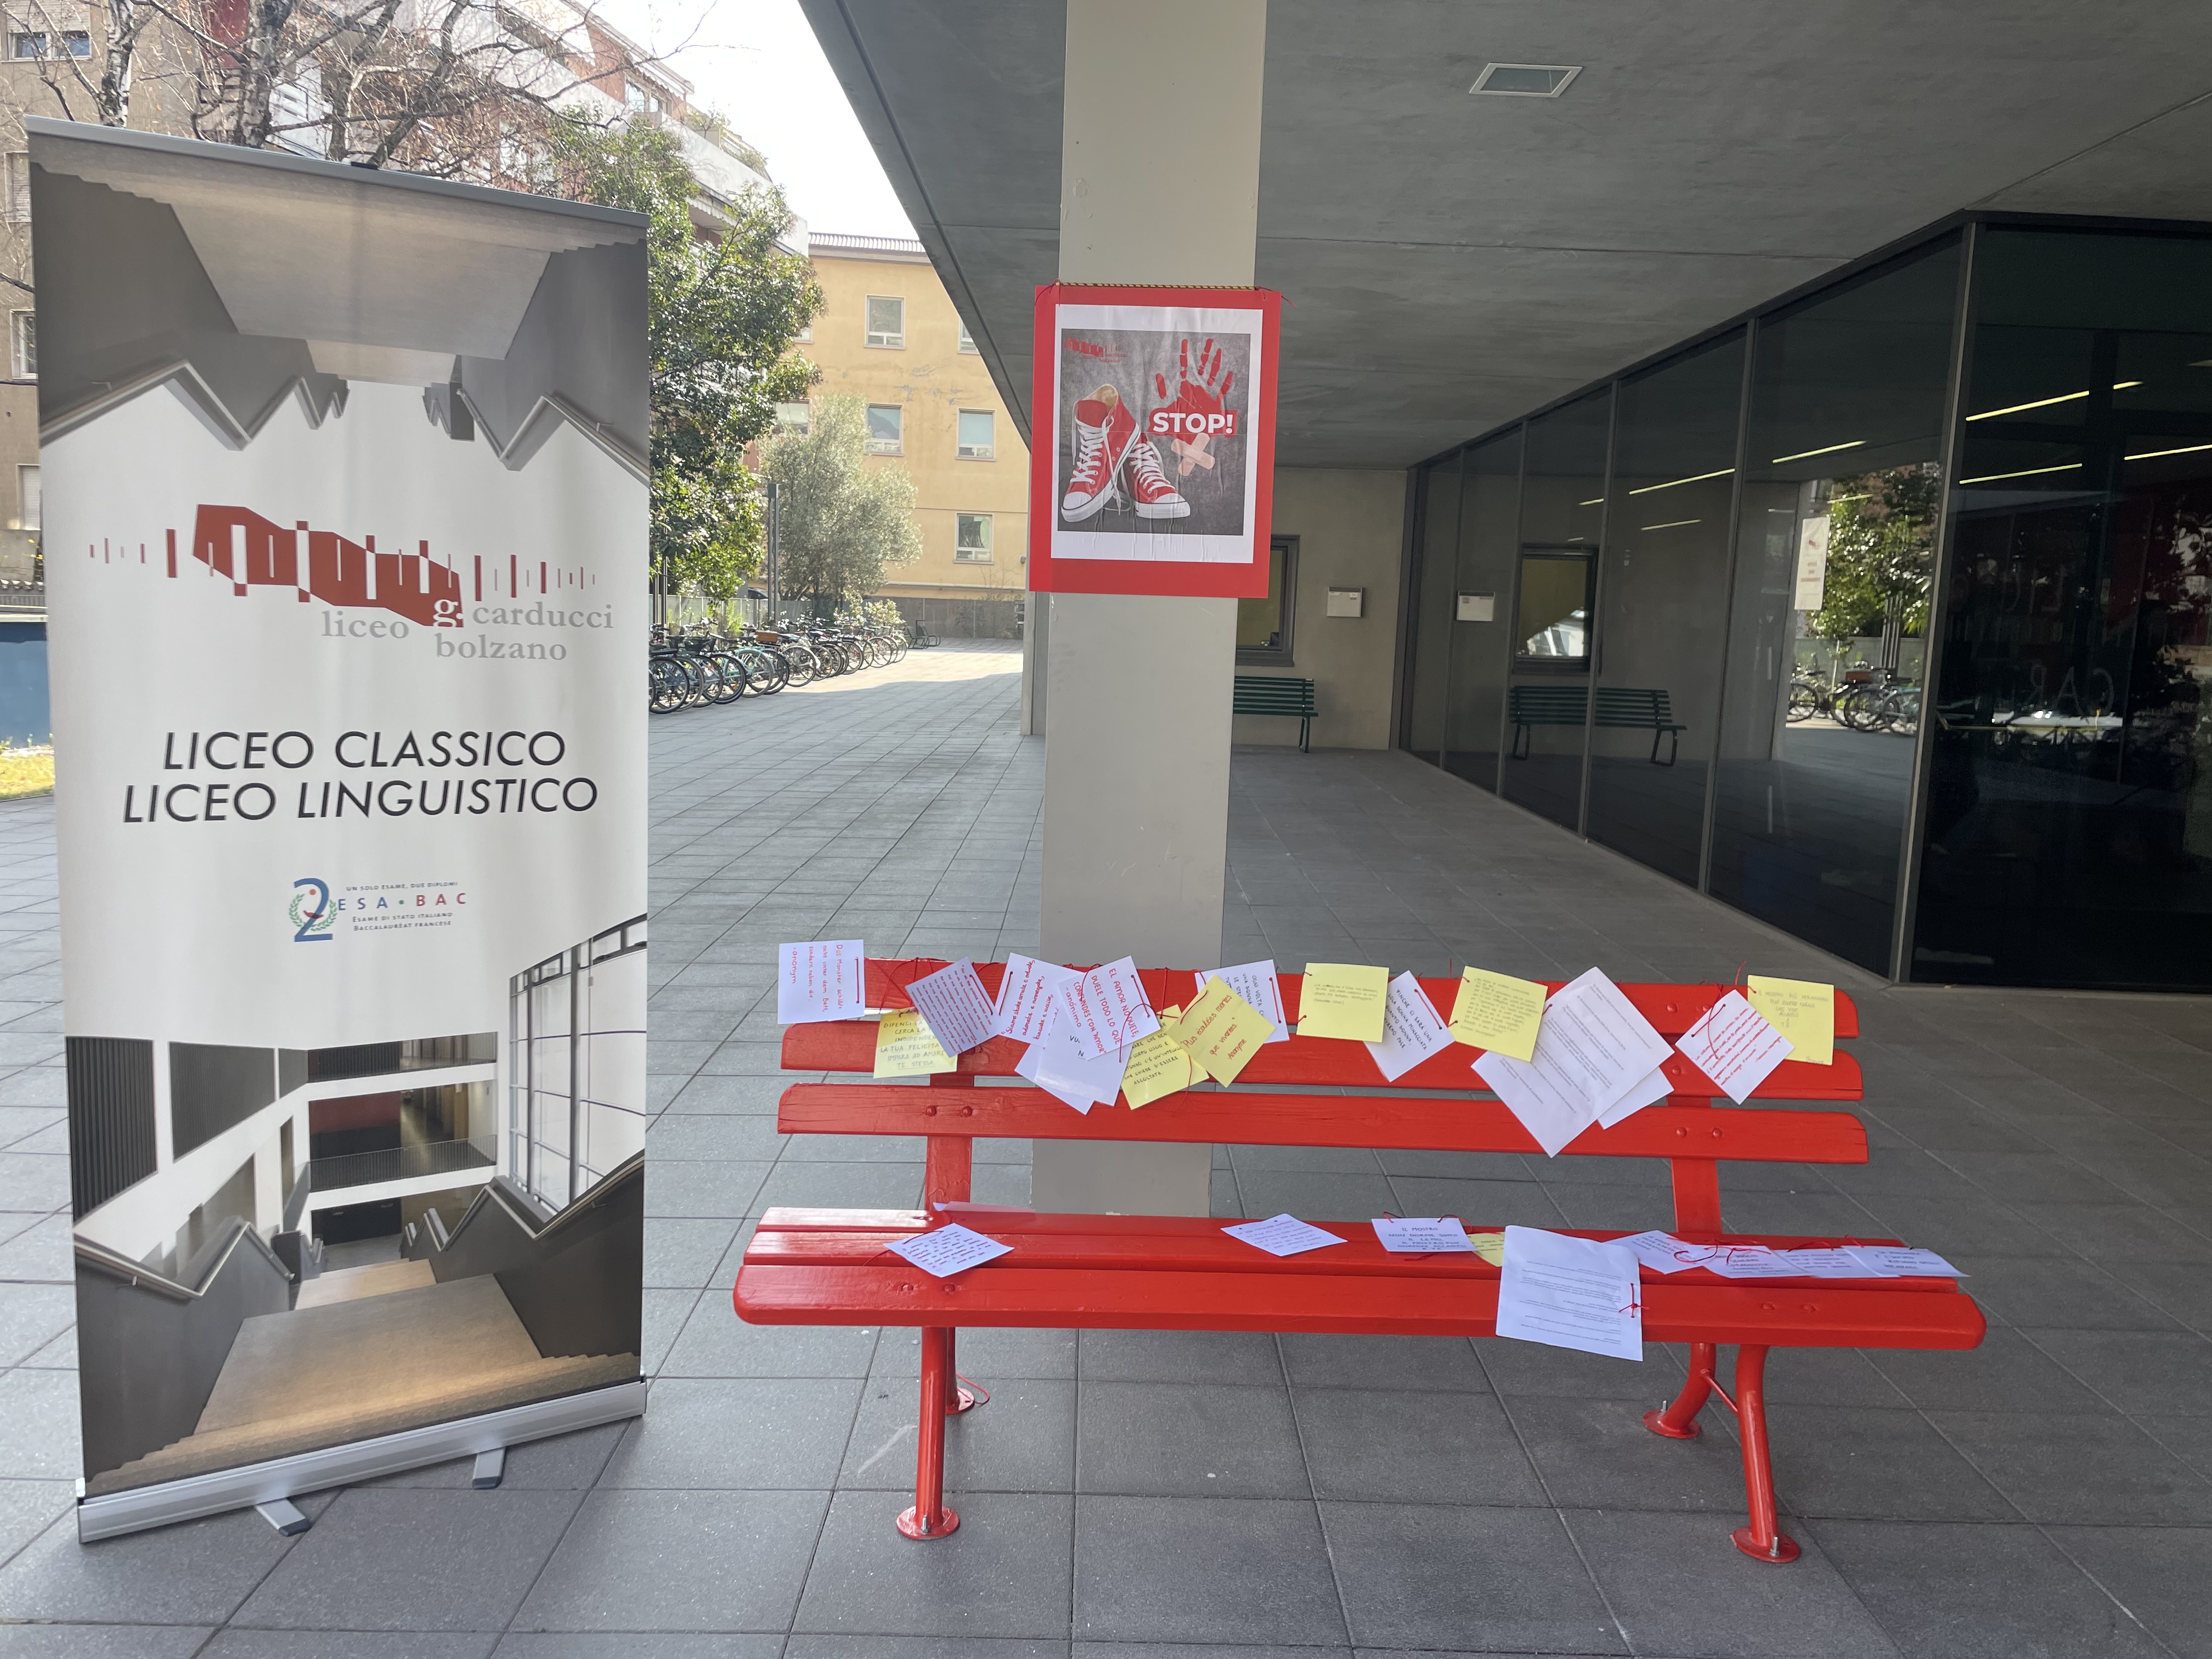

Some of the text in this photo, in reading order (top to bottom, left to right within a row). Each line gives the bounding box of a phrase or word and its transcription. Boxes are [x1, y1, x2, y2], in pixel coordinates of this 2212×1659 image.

[1153, 412, 1233, 434] STOP!
[321, 610, 409, 639] liceo
[472, 601, 614, 629] carducci
[435, 633, 567, 661] bolzano
[162, 730, 566, 770] LICEO CLASSICO
[122, 777, 599, 823] LICEO LINGUISTICO
[1018, 984, 1026, 1000] amate
[1109, 968, 1116, 978] EL
[1113, 981, 1126, 1004] AMOR
[1121, 1005, 1131, 1015] NO
[1091, 975, 1122, 1044] DUELE TODO LO QUE
[1215, 994, 1232, 1012] mortes
[1385, 1004, 1399, 1023] QUANTO
[1022, 1012, 1032, 1035] adorate
[1087, 1018, 1096, 1031] CON
[1386, 994, 1427, 1050] SOLA DONNA MINACCIATA
[1396, 1037, 1405, 1048] PACE
[1424, 1030, 1432, 1042] UNA
[1209, 1045, 1220, 1055] que
[1135, 1067, 1151, 1075] CHIEDE
